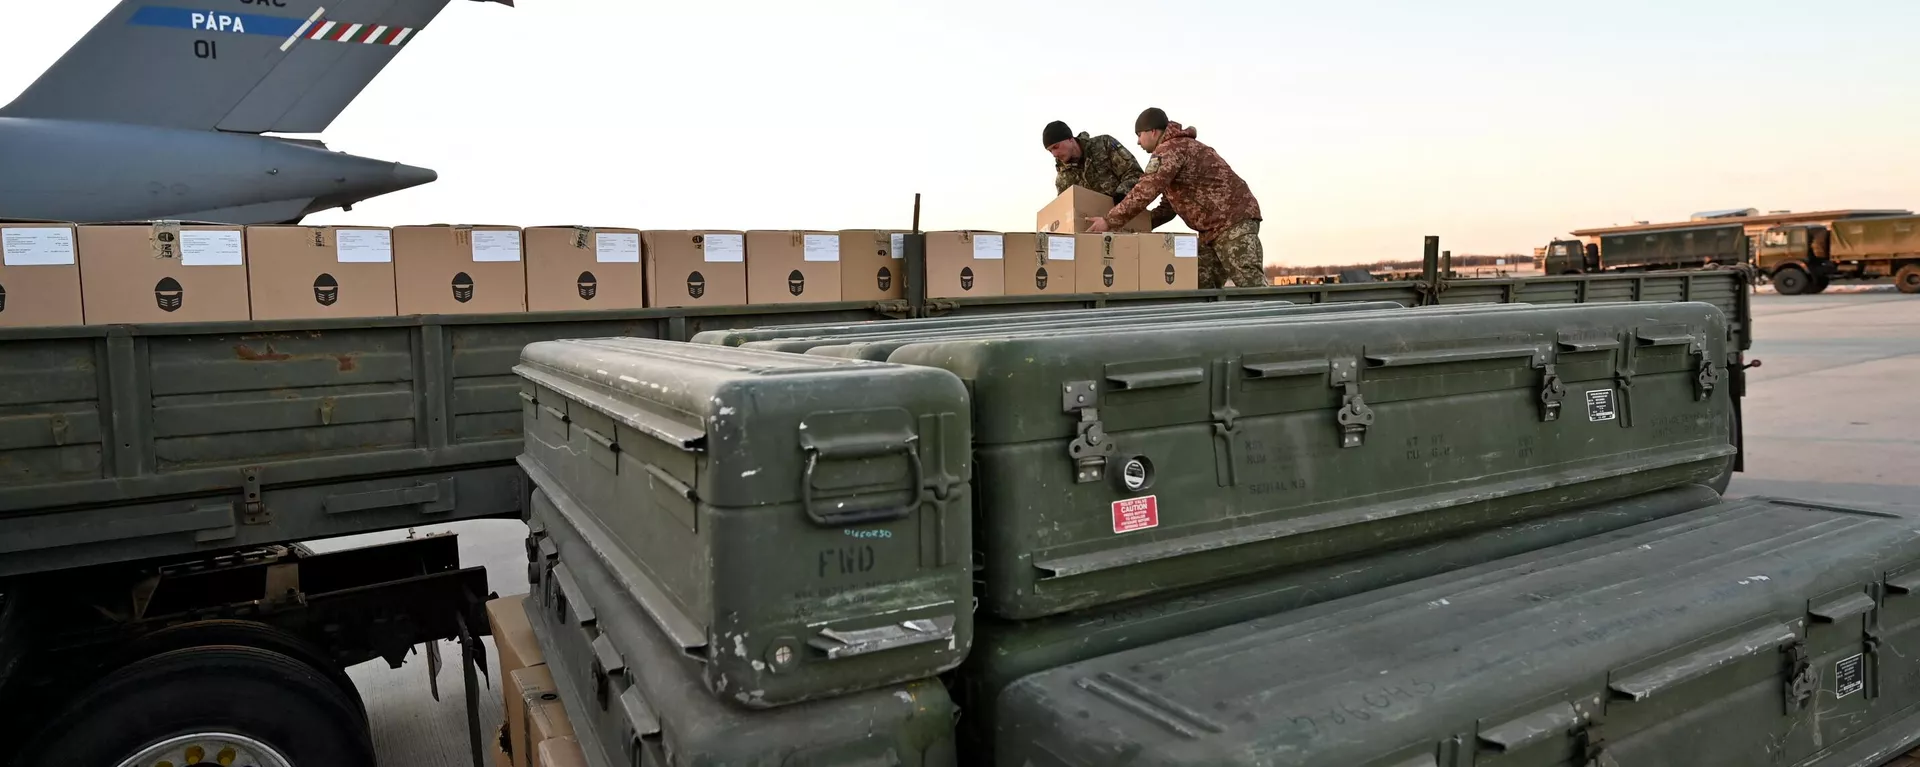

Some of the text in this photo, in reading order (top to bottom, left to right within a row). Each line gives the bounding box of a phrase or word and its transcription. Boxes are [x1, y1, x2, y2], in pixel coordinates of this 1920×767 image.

[191, 11, 245, 33] PÁPA
[1120, 503, 1148, 513] CAUTION
[818, 545, 875, 578] FWD
